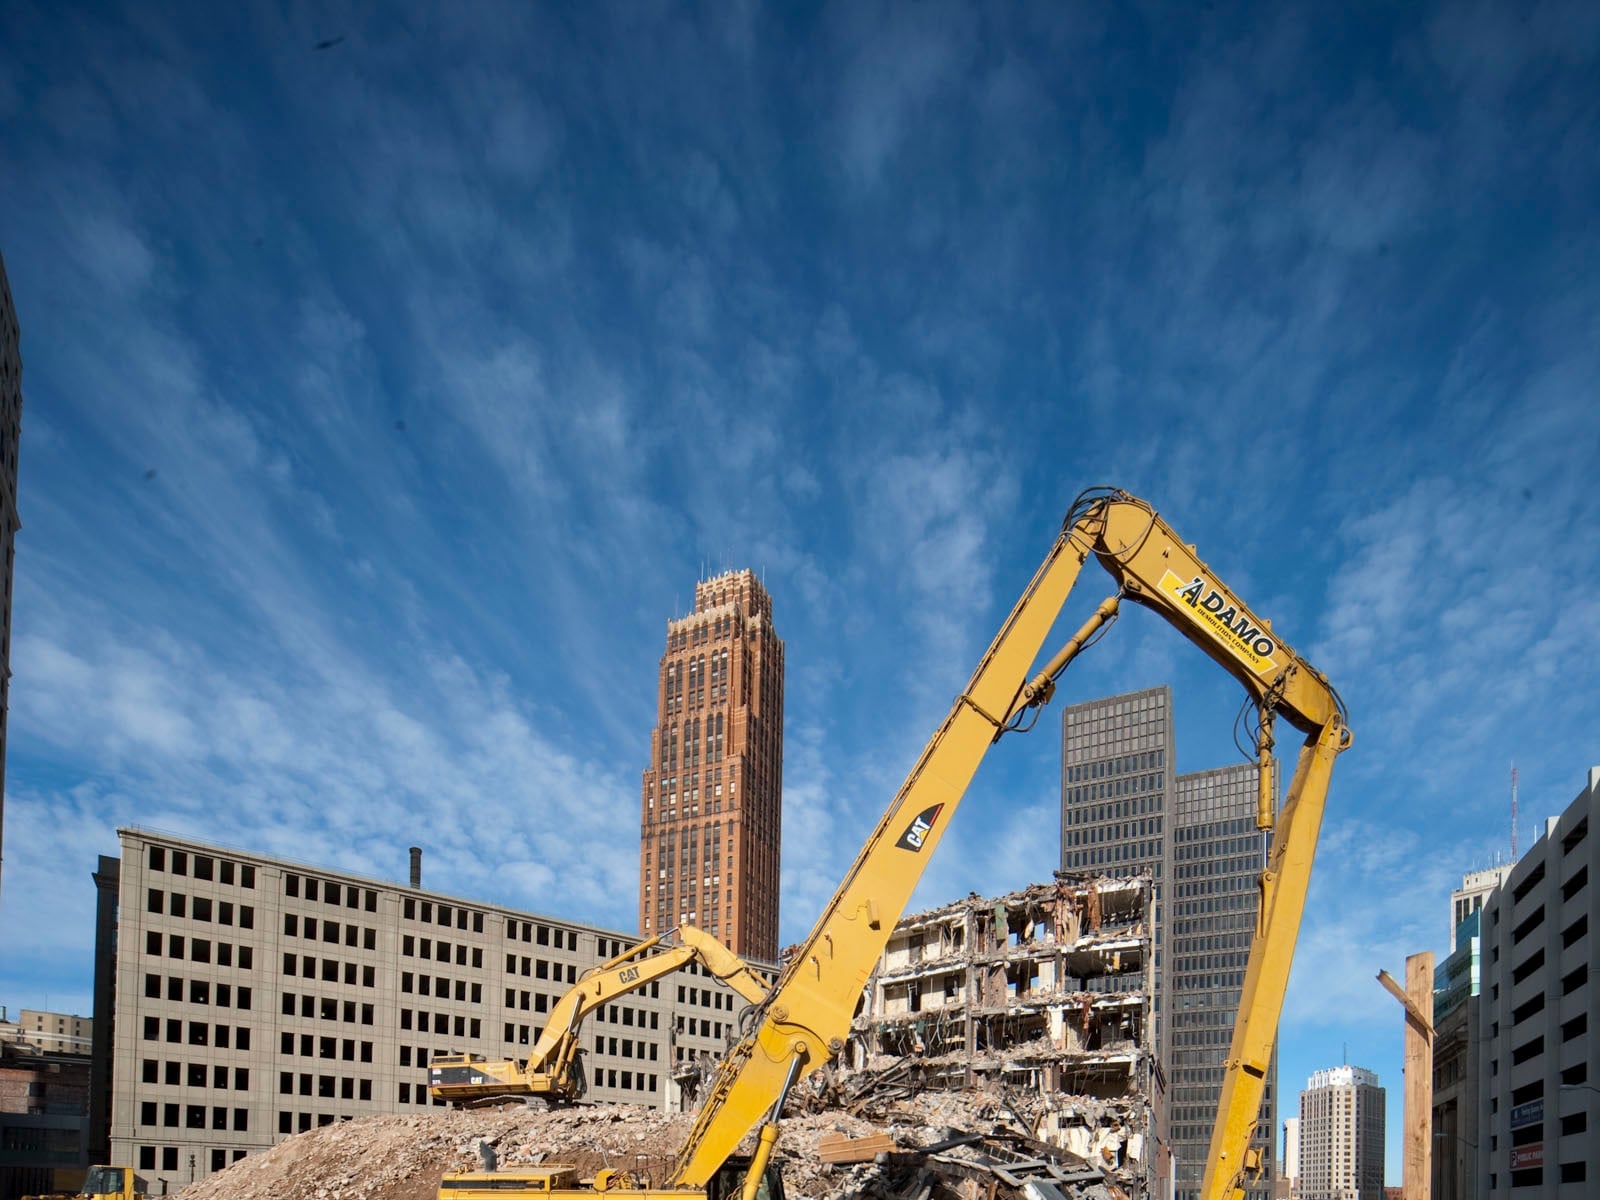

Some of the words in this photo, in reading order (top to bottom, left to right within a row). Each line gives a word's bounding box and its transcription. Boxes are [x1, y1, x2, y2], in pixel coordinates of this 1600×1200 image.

[1175, 577, 1274, 657] ADAMO
[1197, 608, 1232, 640] DEMOLITION
[1231, 638, 1259, 664] COMPANY
[906, 816, 931, 848] CAT
[619, 966, 641, 984] CAT
[470, 1076, 483, 1085] CAT
